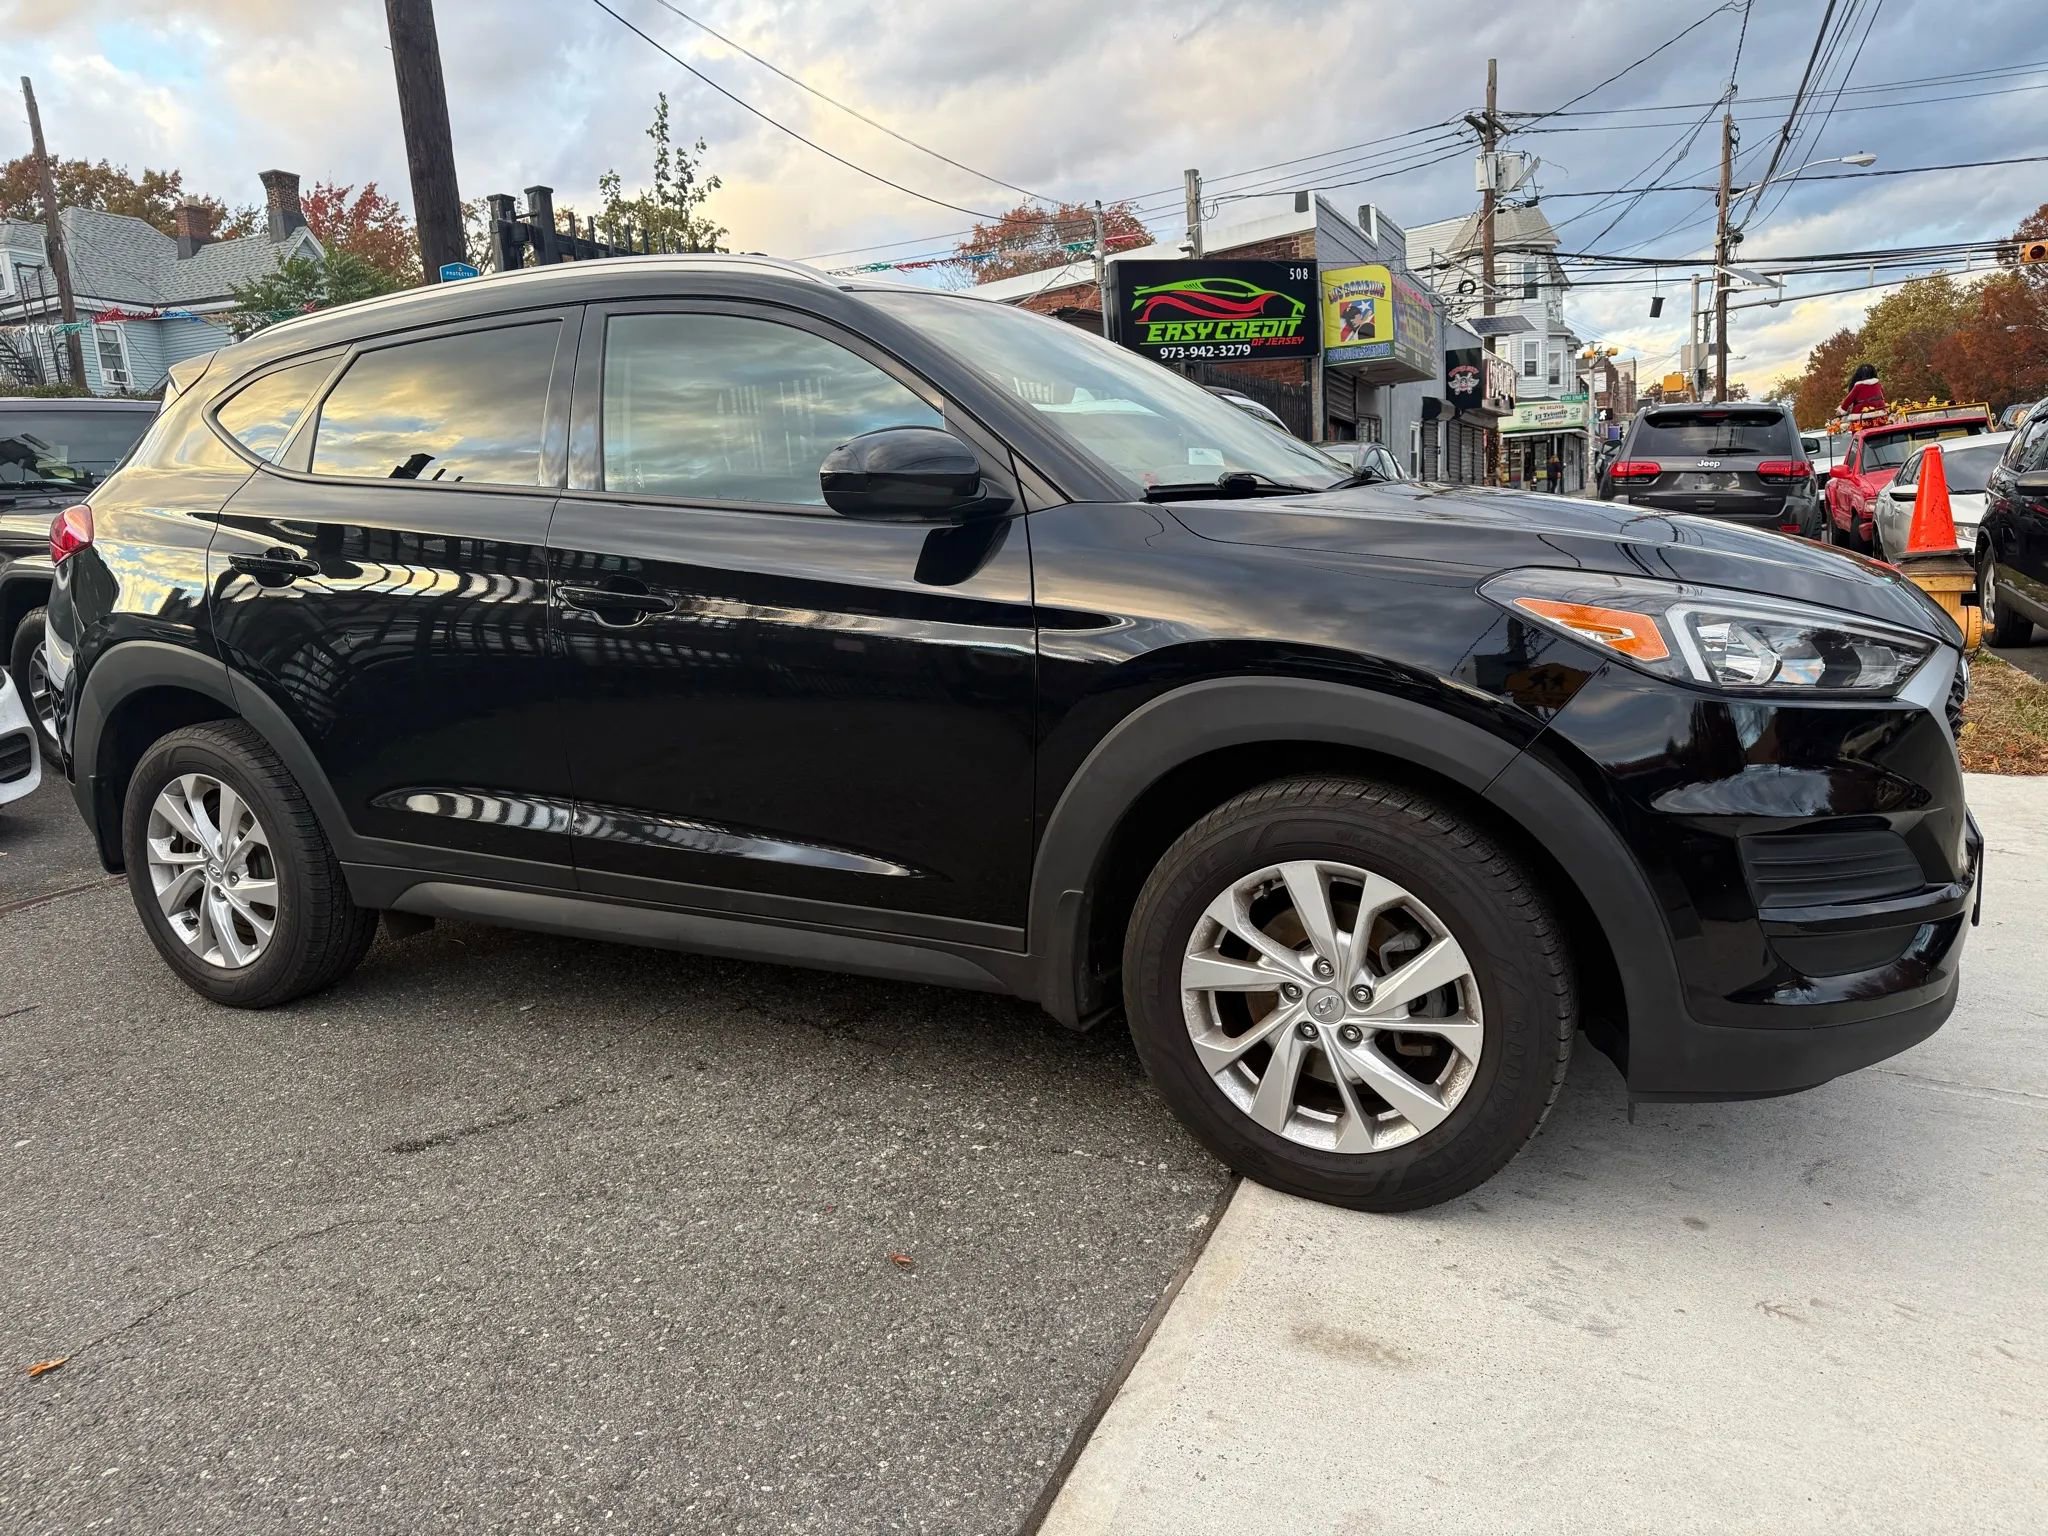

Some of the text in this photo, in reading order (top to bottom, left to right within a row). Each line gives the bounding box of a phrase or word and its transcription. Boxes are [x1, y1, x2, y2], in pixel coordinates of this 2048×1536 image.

[1290, 268, 1308, 280] 508
[1147, 319, 1303, 342] EASY CREDIT
[1251, 336, 1304, 347] OF JERSEY
[1160, 343, 1250, 359] 973-942-3279
[1697, 459, 1720, 469] Jeep
